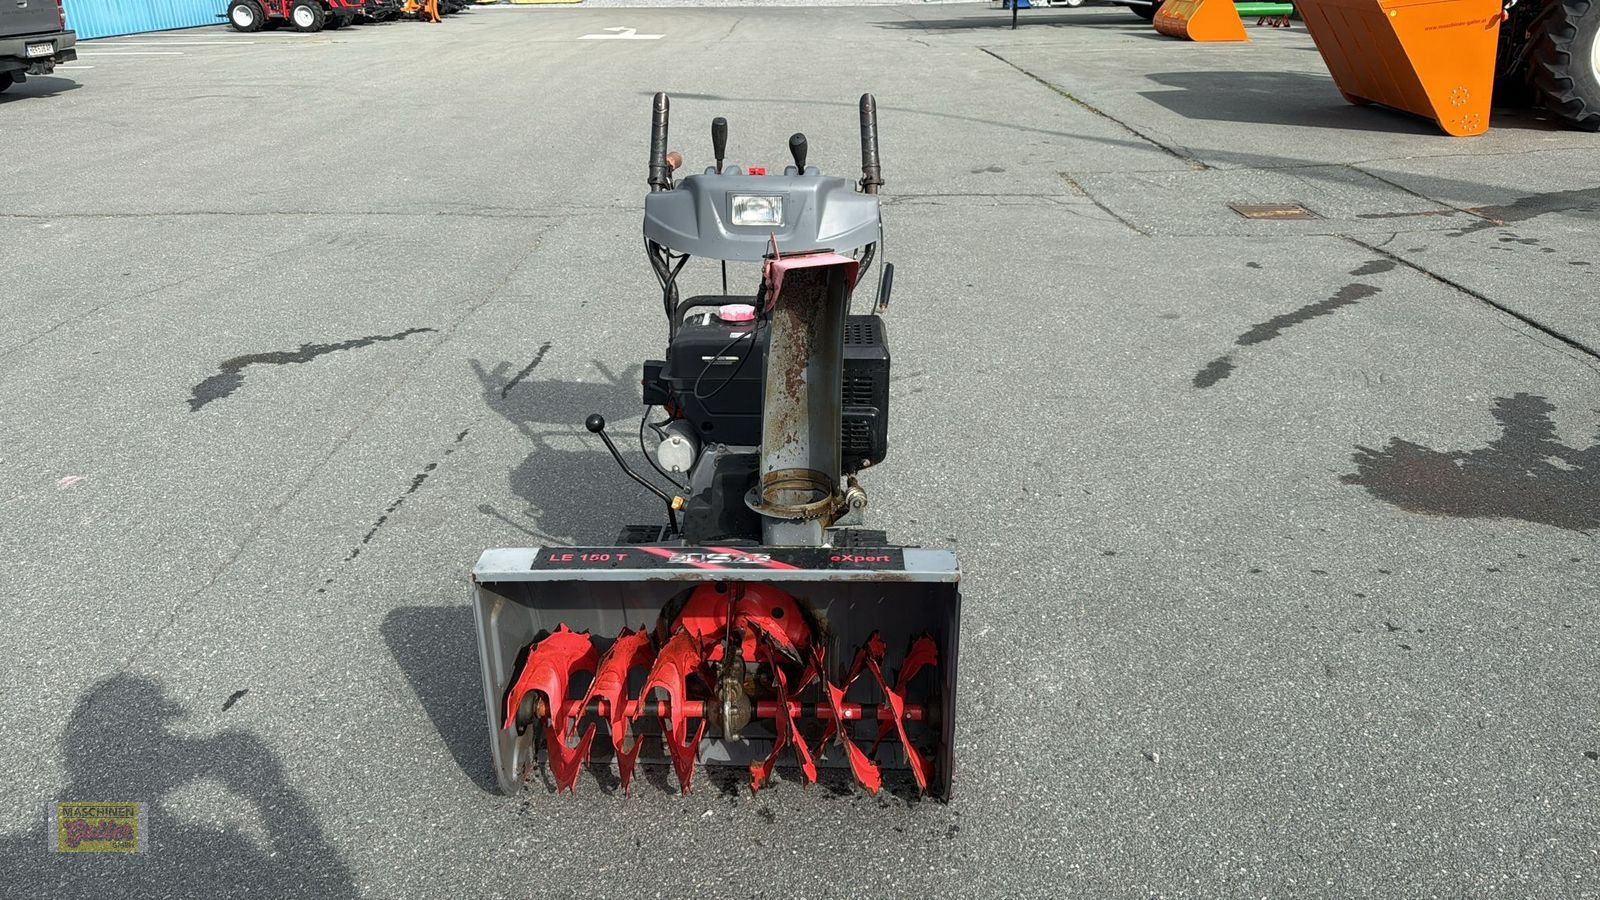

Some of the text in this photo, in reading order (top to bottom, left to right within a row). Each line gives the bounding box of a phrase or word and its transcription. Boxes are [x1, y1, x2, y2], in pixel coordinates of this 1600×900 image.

[549, 553, 628, 562] LE 150 T
[830, 554, 890, 563] eXpert
